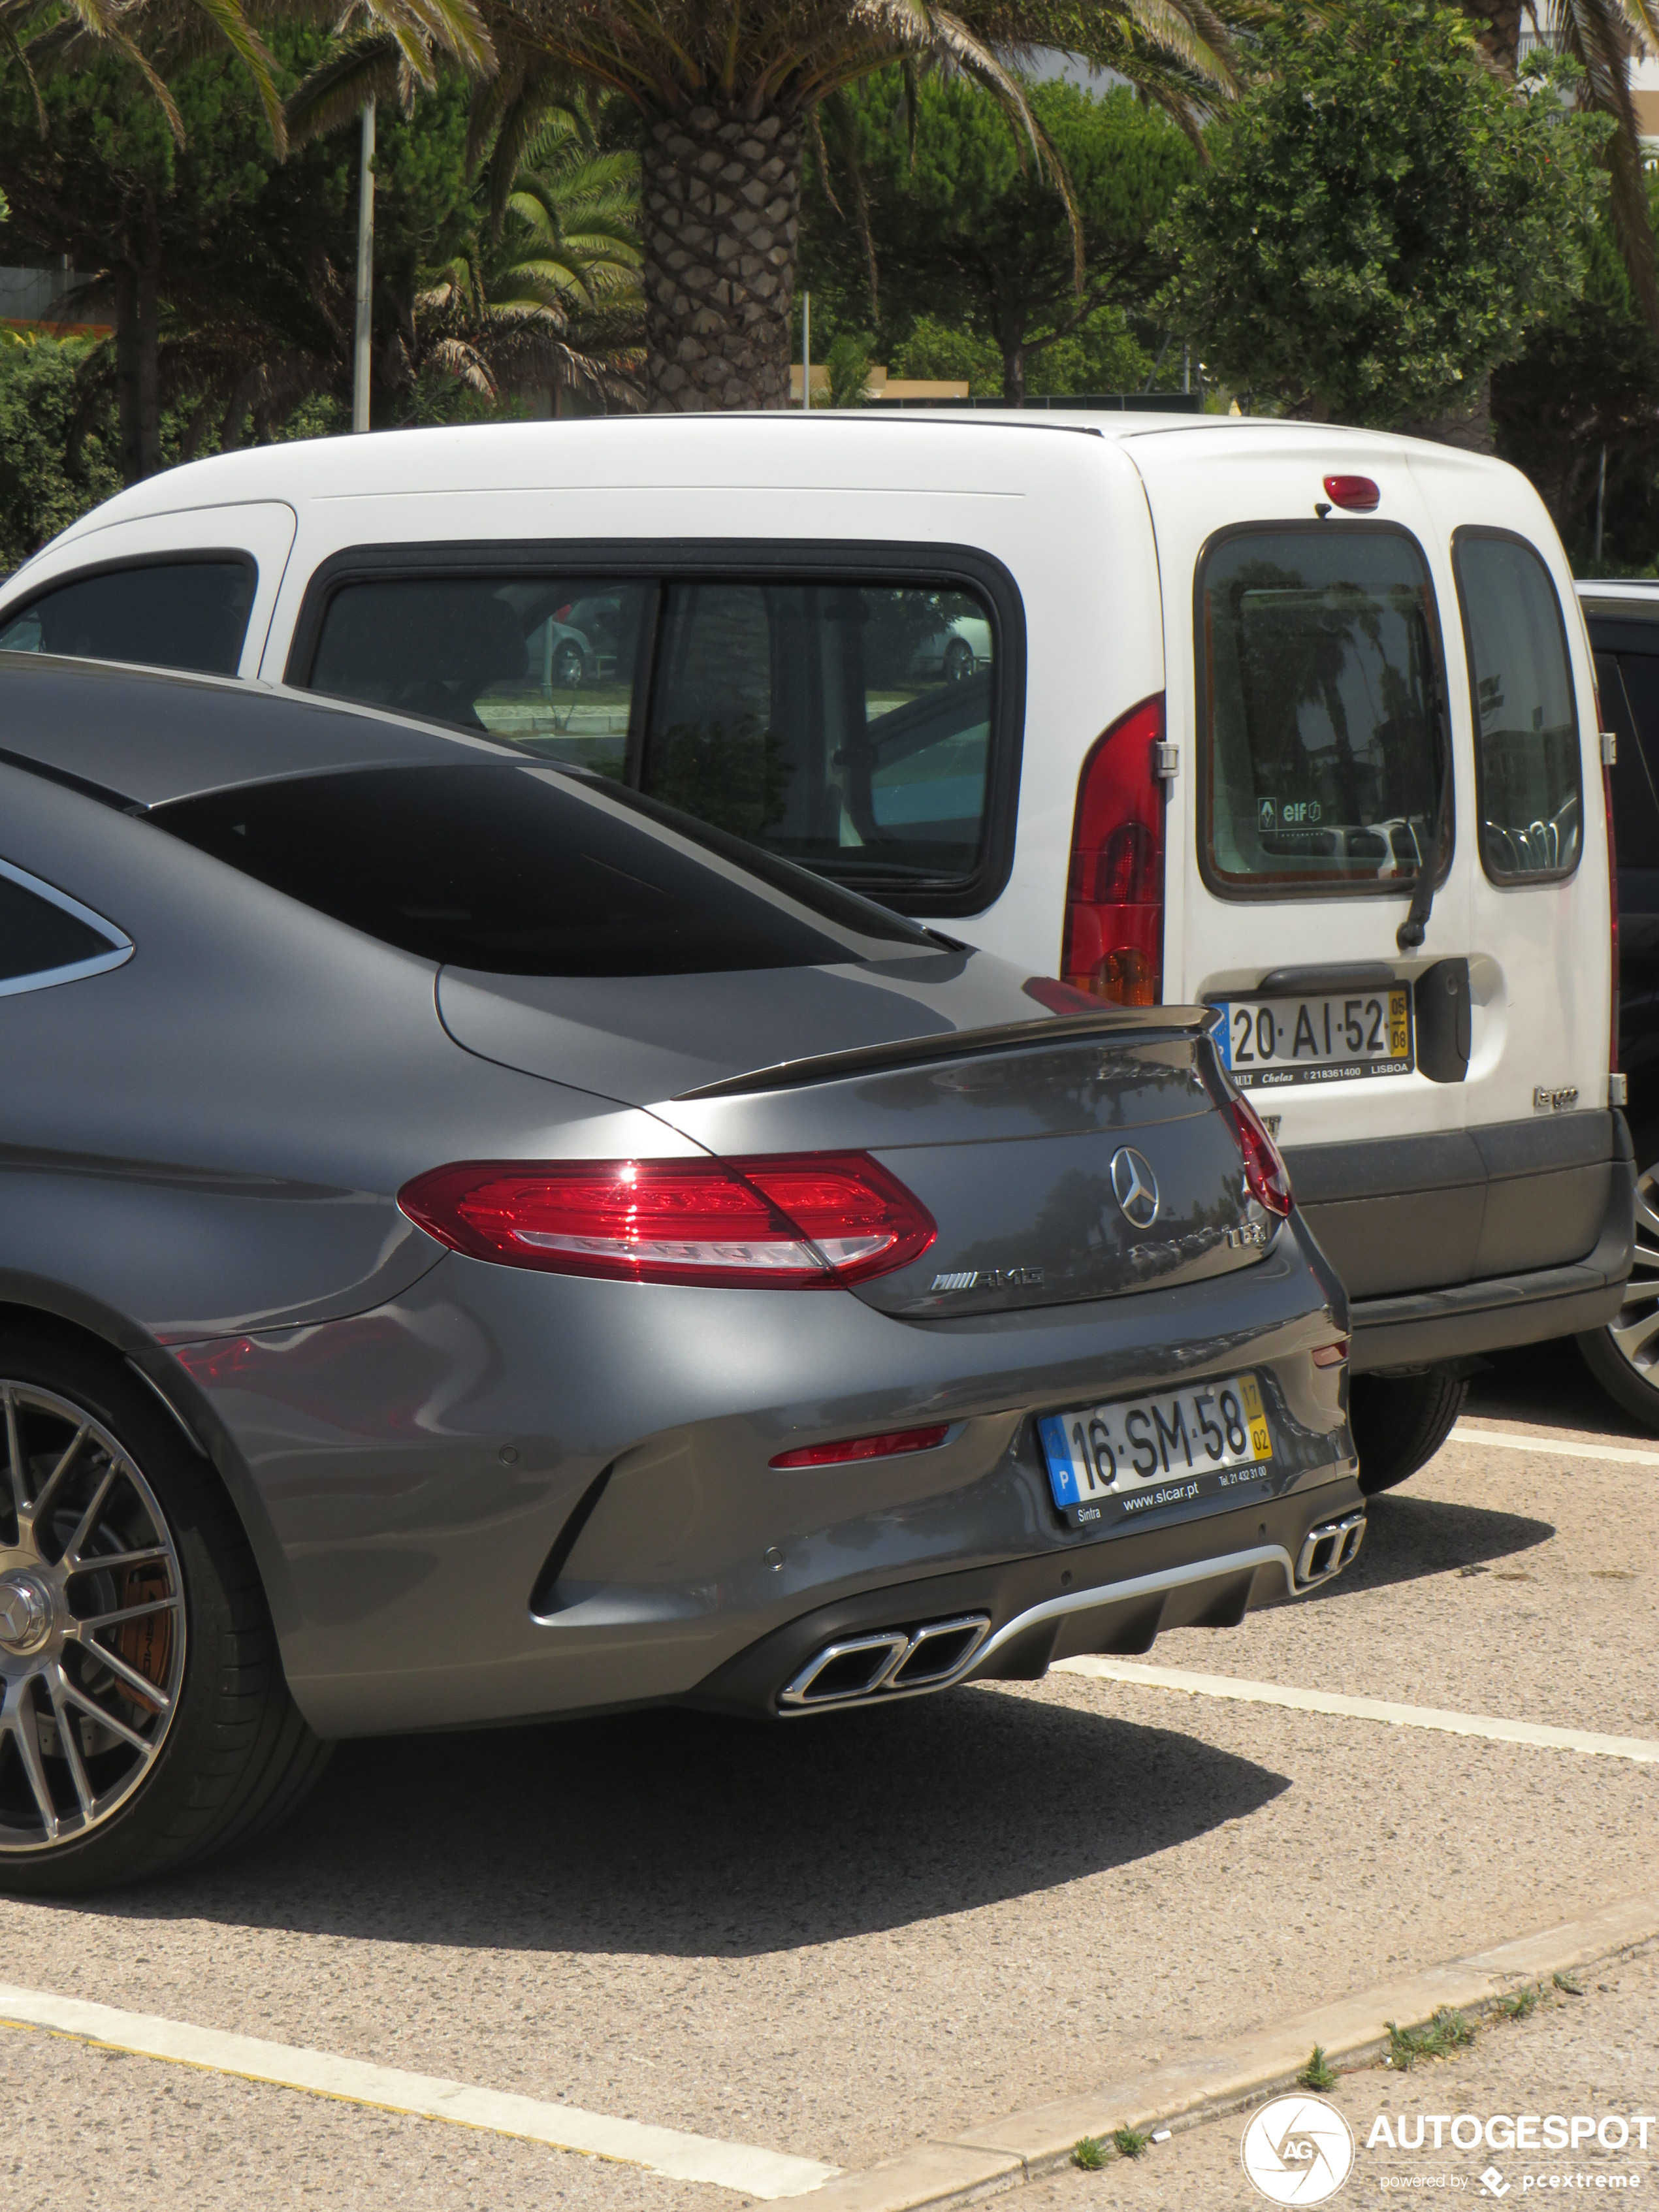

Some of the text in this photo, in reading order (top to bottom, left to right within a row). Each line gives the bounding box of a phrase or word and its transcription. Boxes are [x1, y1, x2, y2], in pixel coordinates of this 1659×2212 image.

[1283, 802, 1306, 822] elf
[1391, 997, 1406, 1016] 05
[1393, 1030, 1406, 1048] 08
[1261, 1072, 1294, 1083] Chelas
[1310, 1067, 1362, 1080] 218361400
[1371, 1063, 1409, 1074] LISBOA
[1243, 1383, 1257, 1407] 17
[1253, 1428, 1269, 1452] 02
[1059, 1471, 1069, 1490] P
[1078, 1466, 1266, 1522] Sintra www.slcar.pt Tel. 21 432 31 00
